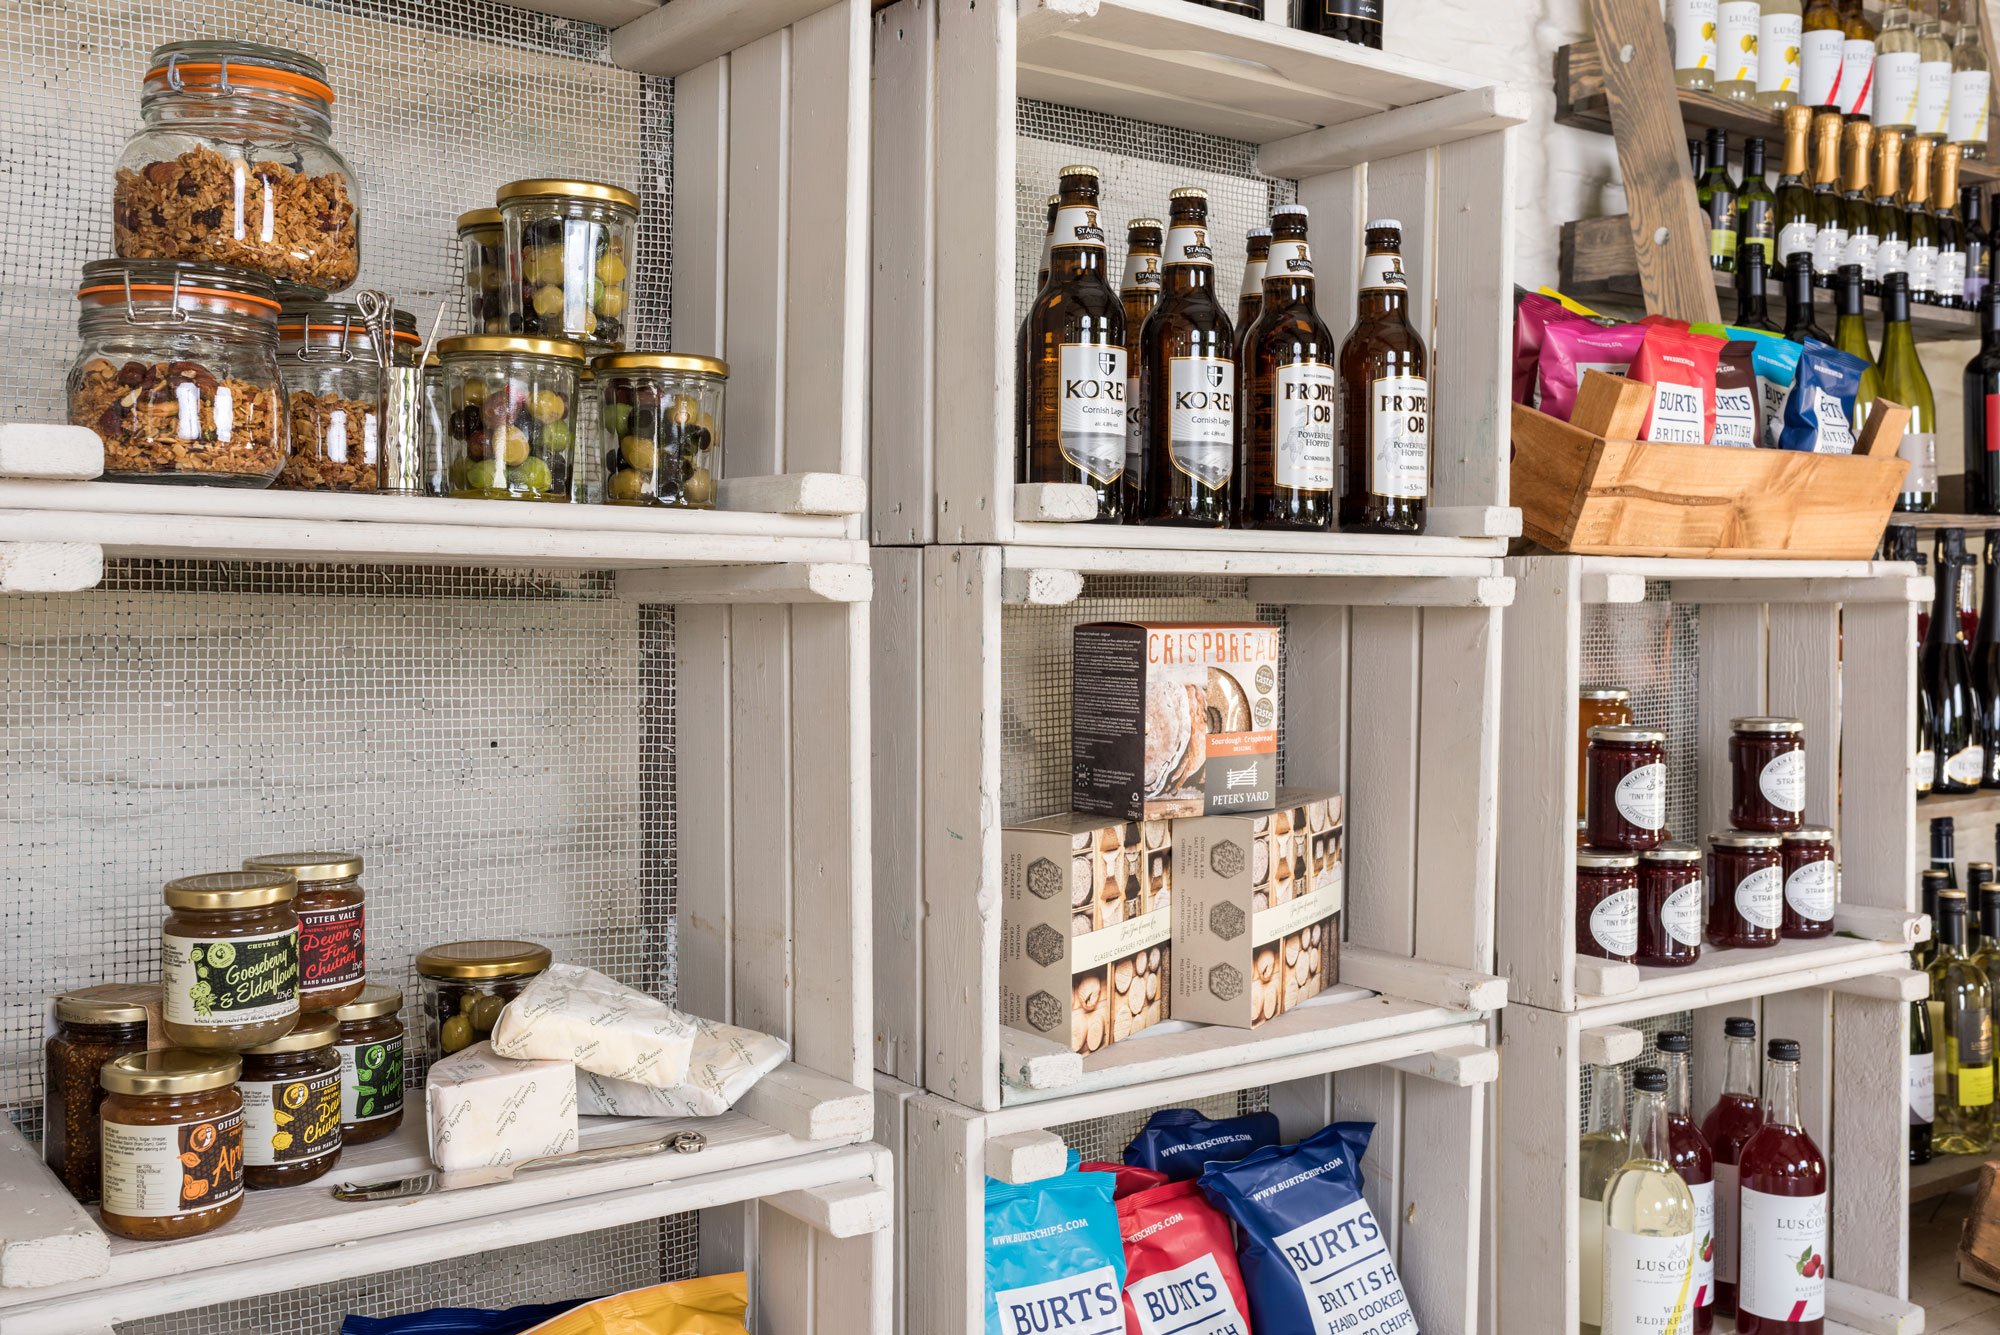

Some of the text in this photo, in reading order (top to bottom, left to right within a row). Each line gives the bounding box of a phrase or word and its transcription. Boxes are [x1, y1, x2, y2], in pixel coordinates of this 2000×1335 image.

[1082, 405, 1109, 414] Cornish
[1660, 391, 1697, 414] BURTS
[1192, 415, 1217, 424] Cornish
[1306, 404, 1331, 427] JOB
[1400, 416, 1425, 436] JOB
[1716, 423, 1751, 439] BRITISH
[1306, 439, 1330, 448] HOPPED
[1655, 427, 1700, 444] BRITISH
[1149, 631, 1277, 664] CRISPBREAD
[1256, 674, 1273, 687] taste
[1255, 707, 1273, 719] taste
[1211, 735, 1273, 746] Sourdough Crispbread
[1624, 772, 1645, 787] WILKIN
[1246, 791, 1269, 802] YARD
[1599, 898, 1619, 914] WILKIN
[1670, 890, 1688, 906] WILKIN
[306, 910, 356, 925] OTTER VALE
[248, 940, 280, 949] CHUTNEY
[299, 928, 351, 952] Devon
[319, 943, 349, 962] Fire
[226, 949, 288, 985] Gooseberry
[306, 948, 356, 979] Chutney
[220, 962, 297, 1008] & Elderflower
[345, 972, 358, 980] DEVON
[506, 1031, 533, 1049] Cheeses
[574, 1040, 600, 1058] Cheeses
[610, 1047, 663, 1080] Country Cheeses
[310, 1078, 333, 1090] OTTER
[448, 1099, 471, 1128] Country
[497, 1081, 536, 1137] Country Cheeses
[218, 1116, 240, 1131] OTTER
[307, 1146, 321, 1154] HAND
[552, 1128, 575, 1155] Country
[1253, 1157, 1343, 1201] WWW.BURTSCHIPS.COM
[214, 1190, 228, 1200] HAND
[992, 1217, 1089, 1246] WWW.BURTSCHIPS.COM
[1285, 1211, 1379, 1272] BURTS
[1143, 1271, 1218, 1323] BURTS
[1317, 1263, 1398, 1314] BRITISH
[1010, 1281, 1118, 1335] BURTS
[1328, 1308, 1358, 1335] HAND
[1357, 1288, 1405, 1321] COOKED
[1664, 1304, 1688, 1314] WILD
[1380, 1308, 1413, 1335] CHIPS
